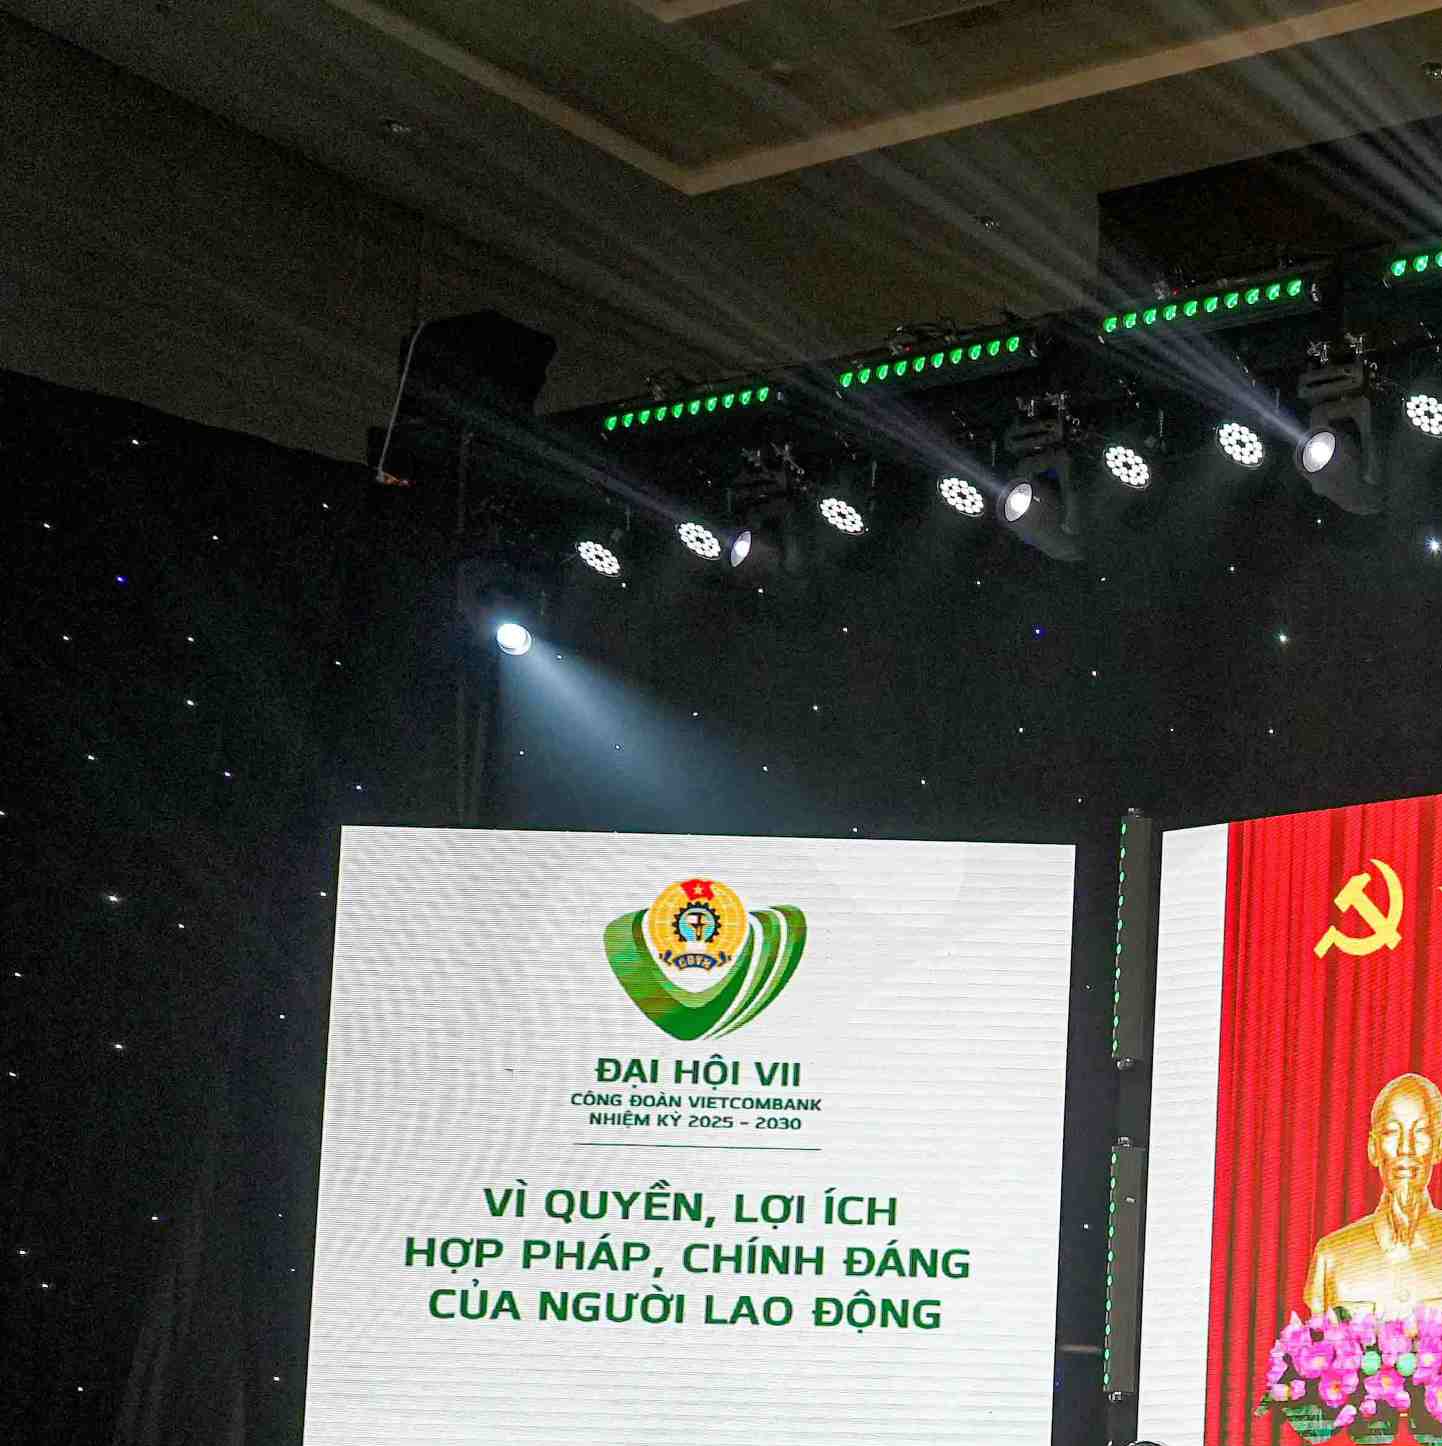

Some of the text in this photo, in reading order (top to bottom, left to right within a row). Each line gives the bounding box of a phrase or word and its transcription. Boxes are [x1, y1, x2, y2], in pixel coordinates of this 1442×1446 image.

[594, 1053, 801, 1091] ĐẠI HỘI VII
[570, 1090, 822, 1112] CÔNG ĐOÀN VIETCOMBANK
[589, 1109, 651, 1127] NHIỆM
[656, 1113, 682, 1127] KỲ
[687, 1114, 734, 1129] 2025
[754, 1116, 802, 1131] 2030
[483, 1178, 897, 1230] VÌ QUYỀN, LỢI ÍCH
[404, 1232, 970, 1280] HỢP PHÁP, CHÍNH ĐÁNG
[428, 1278, 942, 1334] CỦA NGƯỜI LAO ĐỘNG
